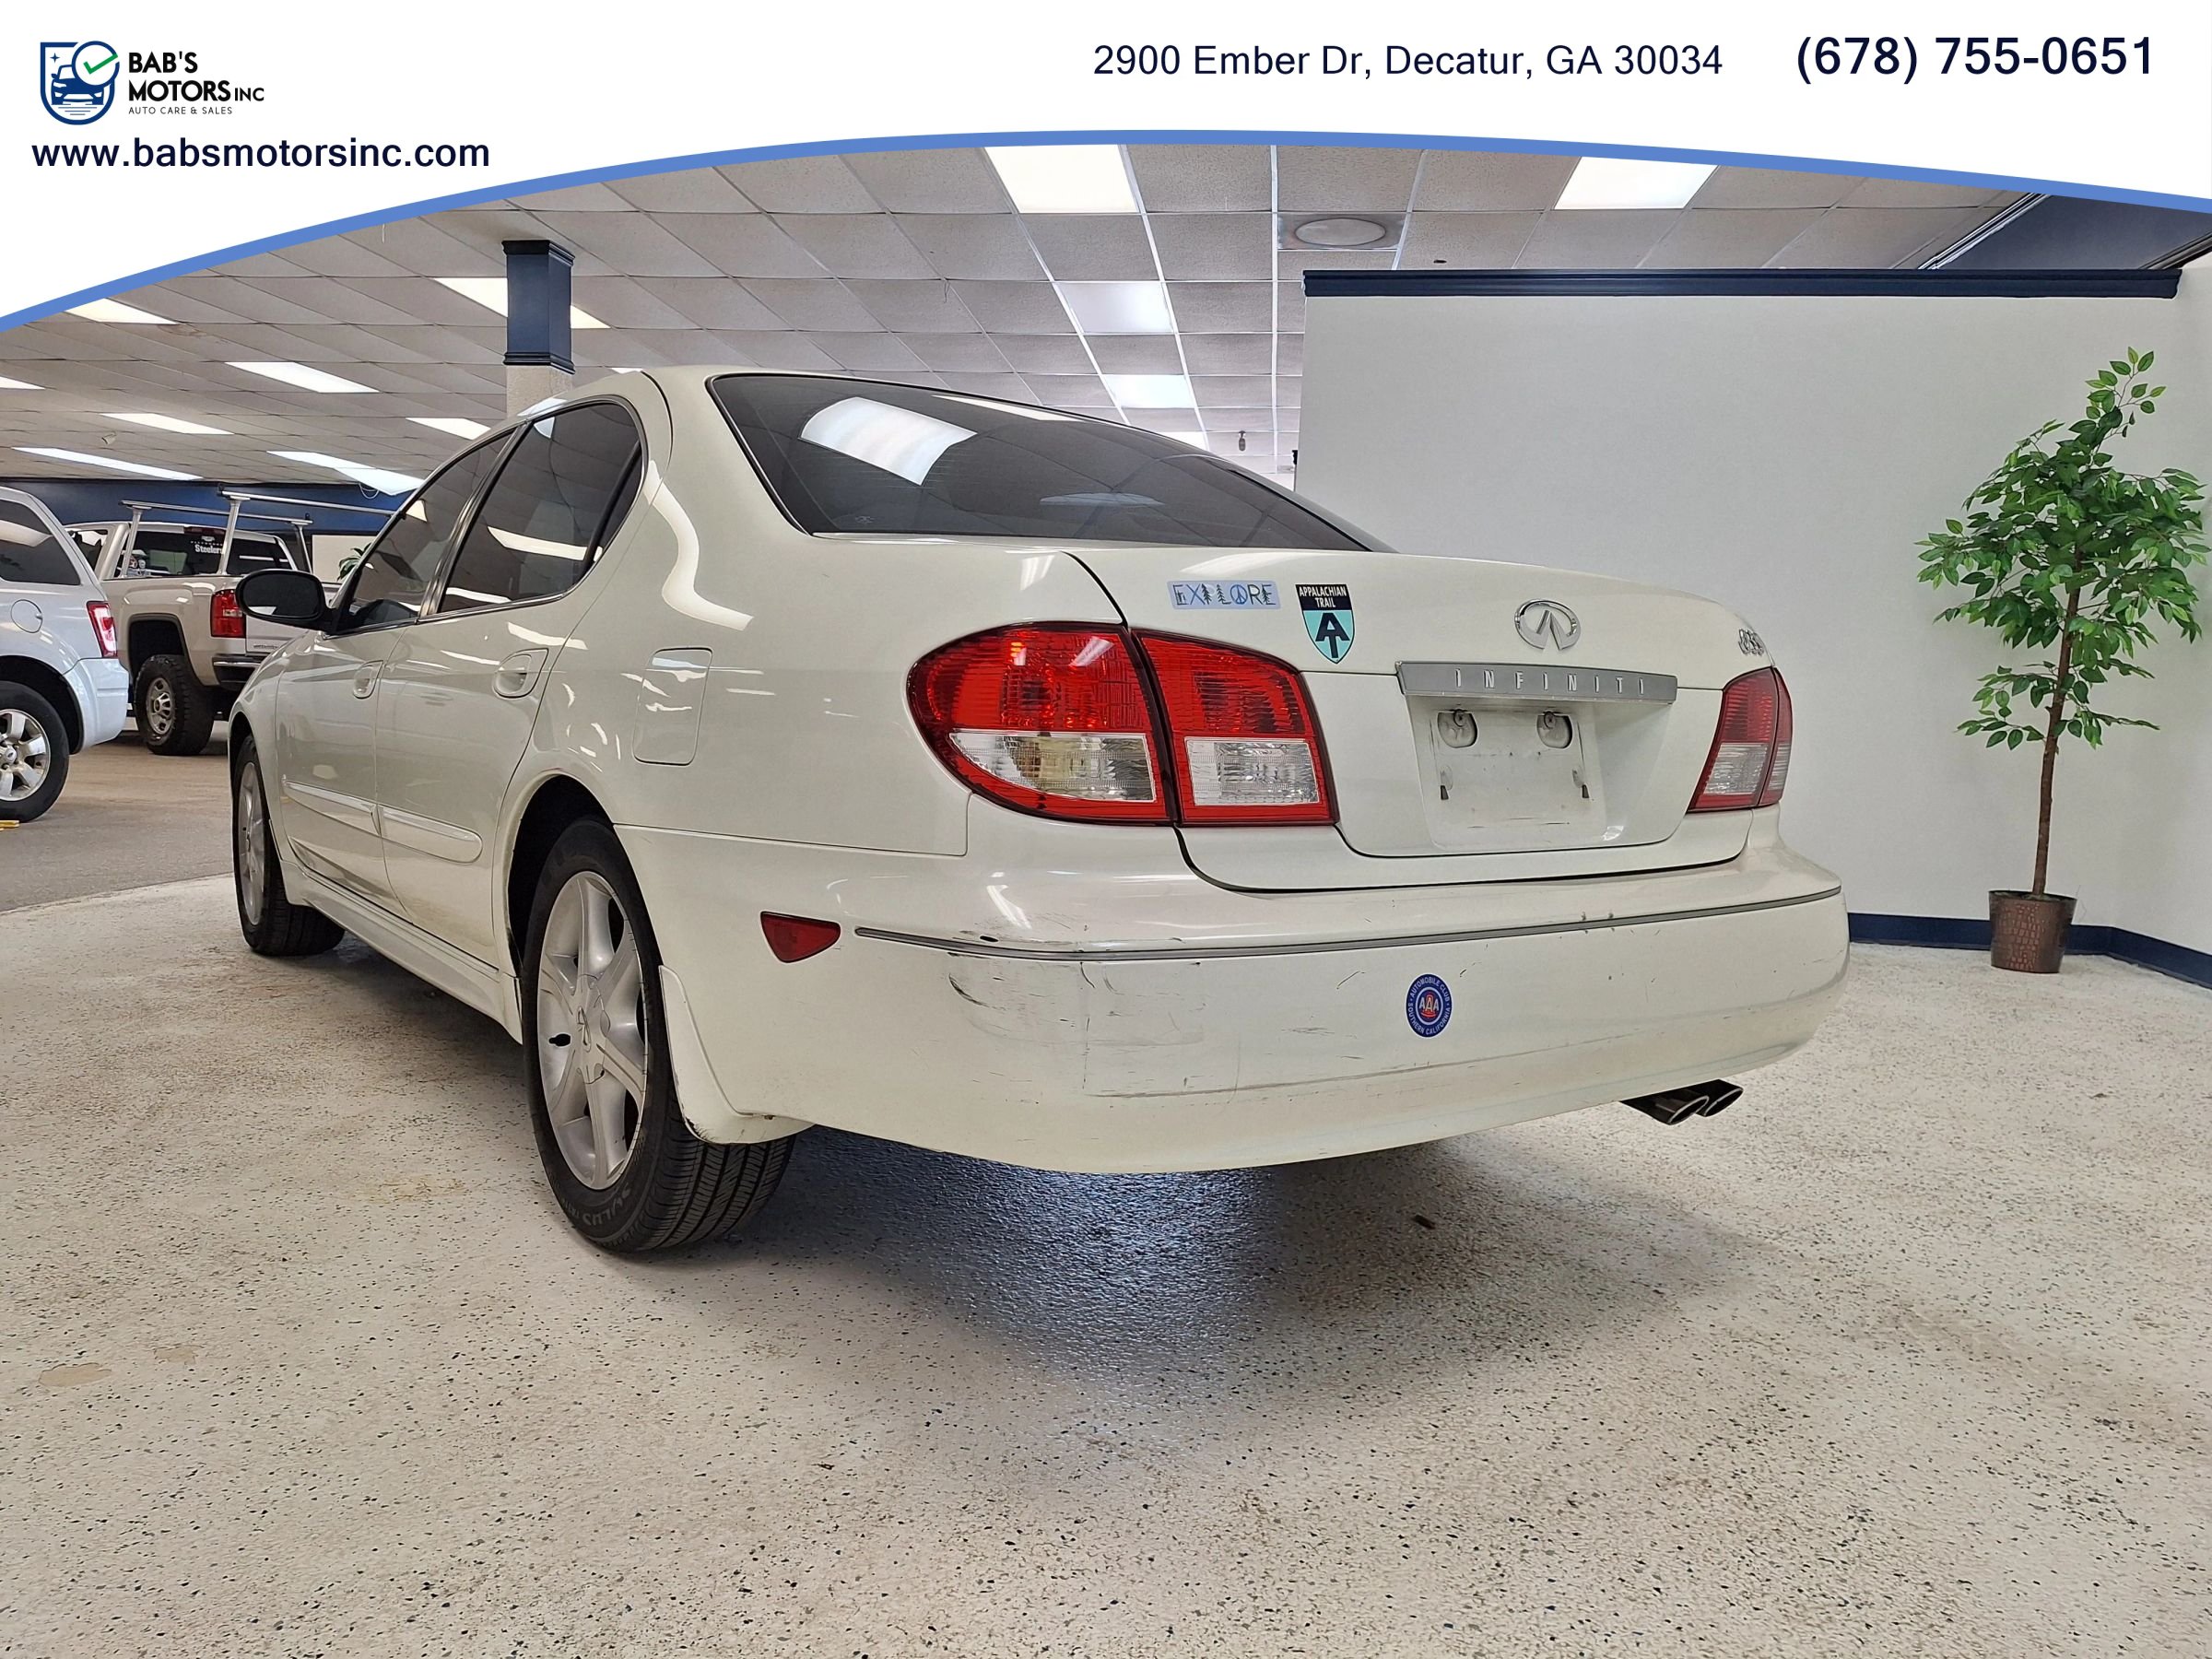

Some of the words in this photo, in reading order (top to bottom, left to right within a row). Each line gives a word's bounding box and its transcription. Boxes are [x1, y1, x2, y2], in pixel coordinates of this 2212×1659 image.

[1172, 582, 1277, 606] EXPLORE
[1299, 585, 1347, 597] APPALACHIAN
[1314, 597, 1336, 608] TRAIL
[1453, 668, 1645, 695] INFINITI
[1410, 976, 1441, 998] AUTOMOBILE
[1440, 983, 1451, 1002] CLUB
[1418, 994, 1440, 1012] AAA
[1407, 1002, 1425, 1034] SOUTHERN
[1425, 1006, 1451, 1035] CALIFORNIA
